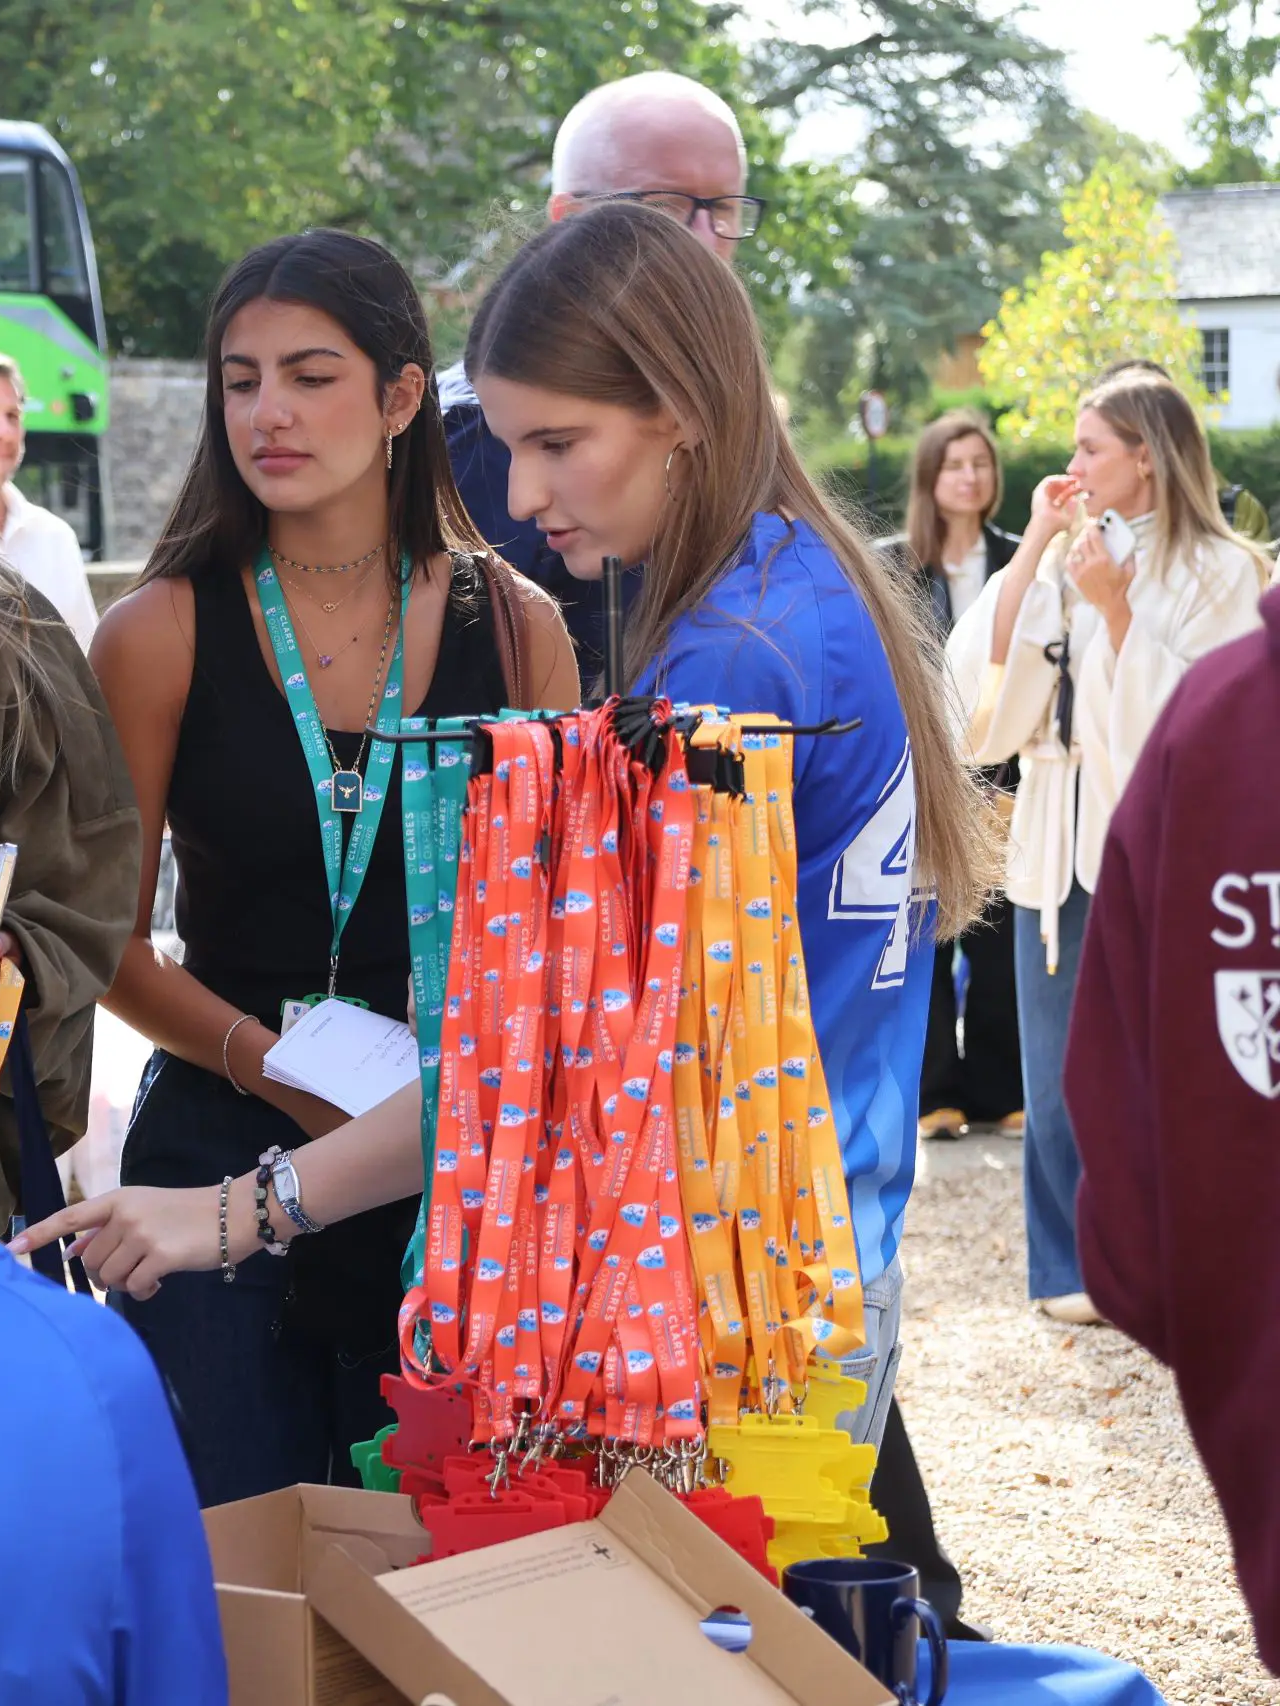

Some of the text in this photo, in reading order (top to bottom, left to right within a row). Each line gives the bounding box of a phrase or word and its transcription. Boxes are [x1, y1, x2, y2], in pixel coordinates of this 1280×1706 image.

[280, 615, 295, 651] CLARES
[310, 720, 326, 756] CLARES
[439, 797, 447, 846] CLARES
[480, 783, 489, 833] CLARES
[527, 771, 536, 824] CLARES
[574, 792, 590, 843] CLARES
[348, 824, 363, 860] CLARES
[359, 826, 374, 864] OXFORD
[405, 812, 414, 860] CLARES
[421, 811, 431, 860] OXFORD
[676, 839, 691, 890] CLARES
[827, 735, 936, 990] 4
[453, 896, 464, 947] CLARES
[600, 890, 610, 942] CLARES
[413, 956, 425, 1003] CLARES
[428, 953, 441, 1002] OXFORD
[562, 946, 573, 997] CLARES
[670, 966, 681, 1018] CLARES
[509, 1006, 526, 1056] CLARES
[598, 1011, 616, 1062] CLARES
[648, 995, 666, 1046] CLARES
[441, 1051, 453, 1102] CLARES
[458, 1089, 470, 1141] CLARES
[470, 1089, 482, 1142] OXFORD
[599, 1146, 618, 1197] OXFORD
[648, 1120, 665, 1173] CLARES
[486, 1159, 504, 1211] CLARES
[612, 1147, 632, 1198] CLARES
[430, 1204, 443, 1256] CLARES
[447, 1205, 460, 1257] OXFORD
[543, 1203, 558, 1254] CLARES
[561, 1204, 574, 1257] OXFORD
[508, 1240, 518, 1292] CLARES
[588, 1268, 610, 1319] OXFORD
[604, 1271, 627, 1322] CLARES
[748, 1271, 761, 1322] CLARES
[464, 1312, 481, 1363] CLARES
[651, 1318, 669, 1371] OXFORD
[668, 1315, 687, 1368] CLARES
[606, 1345, 617, 1394] CLARES
